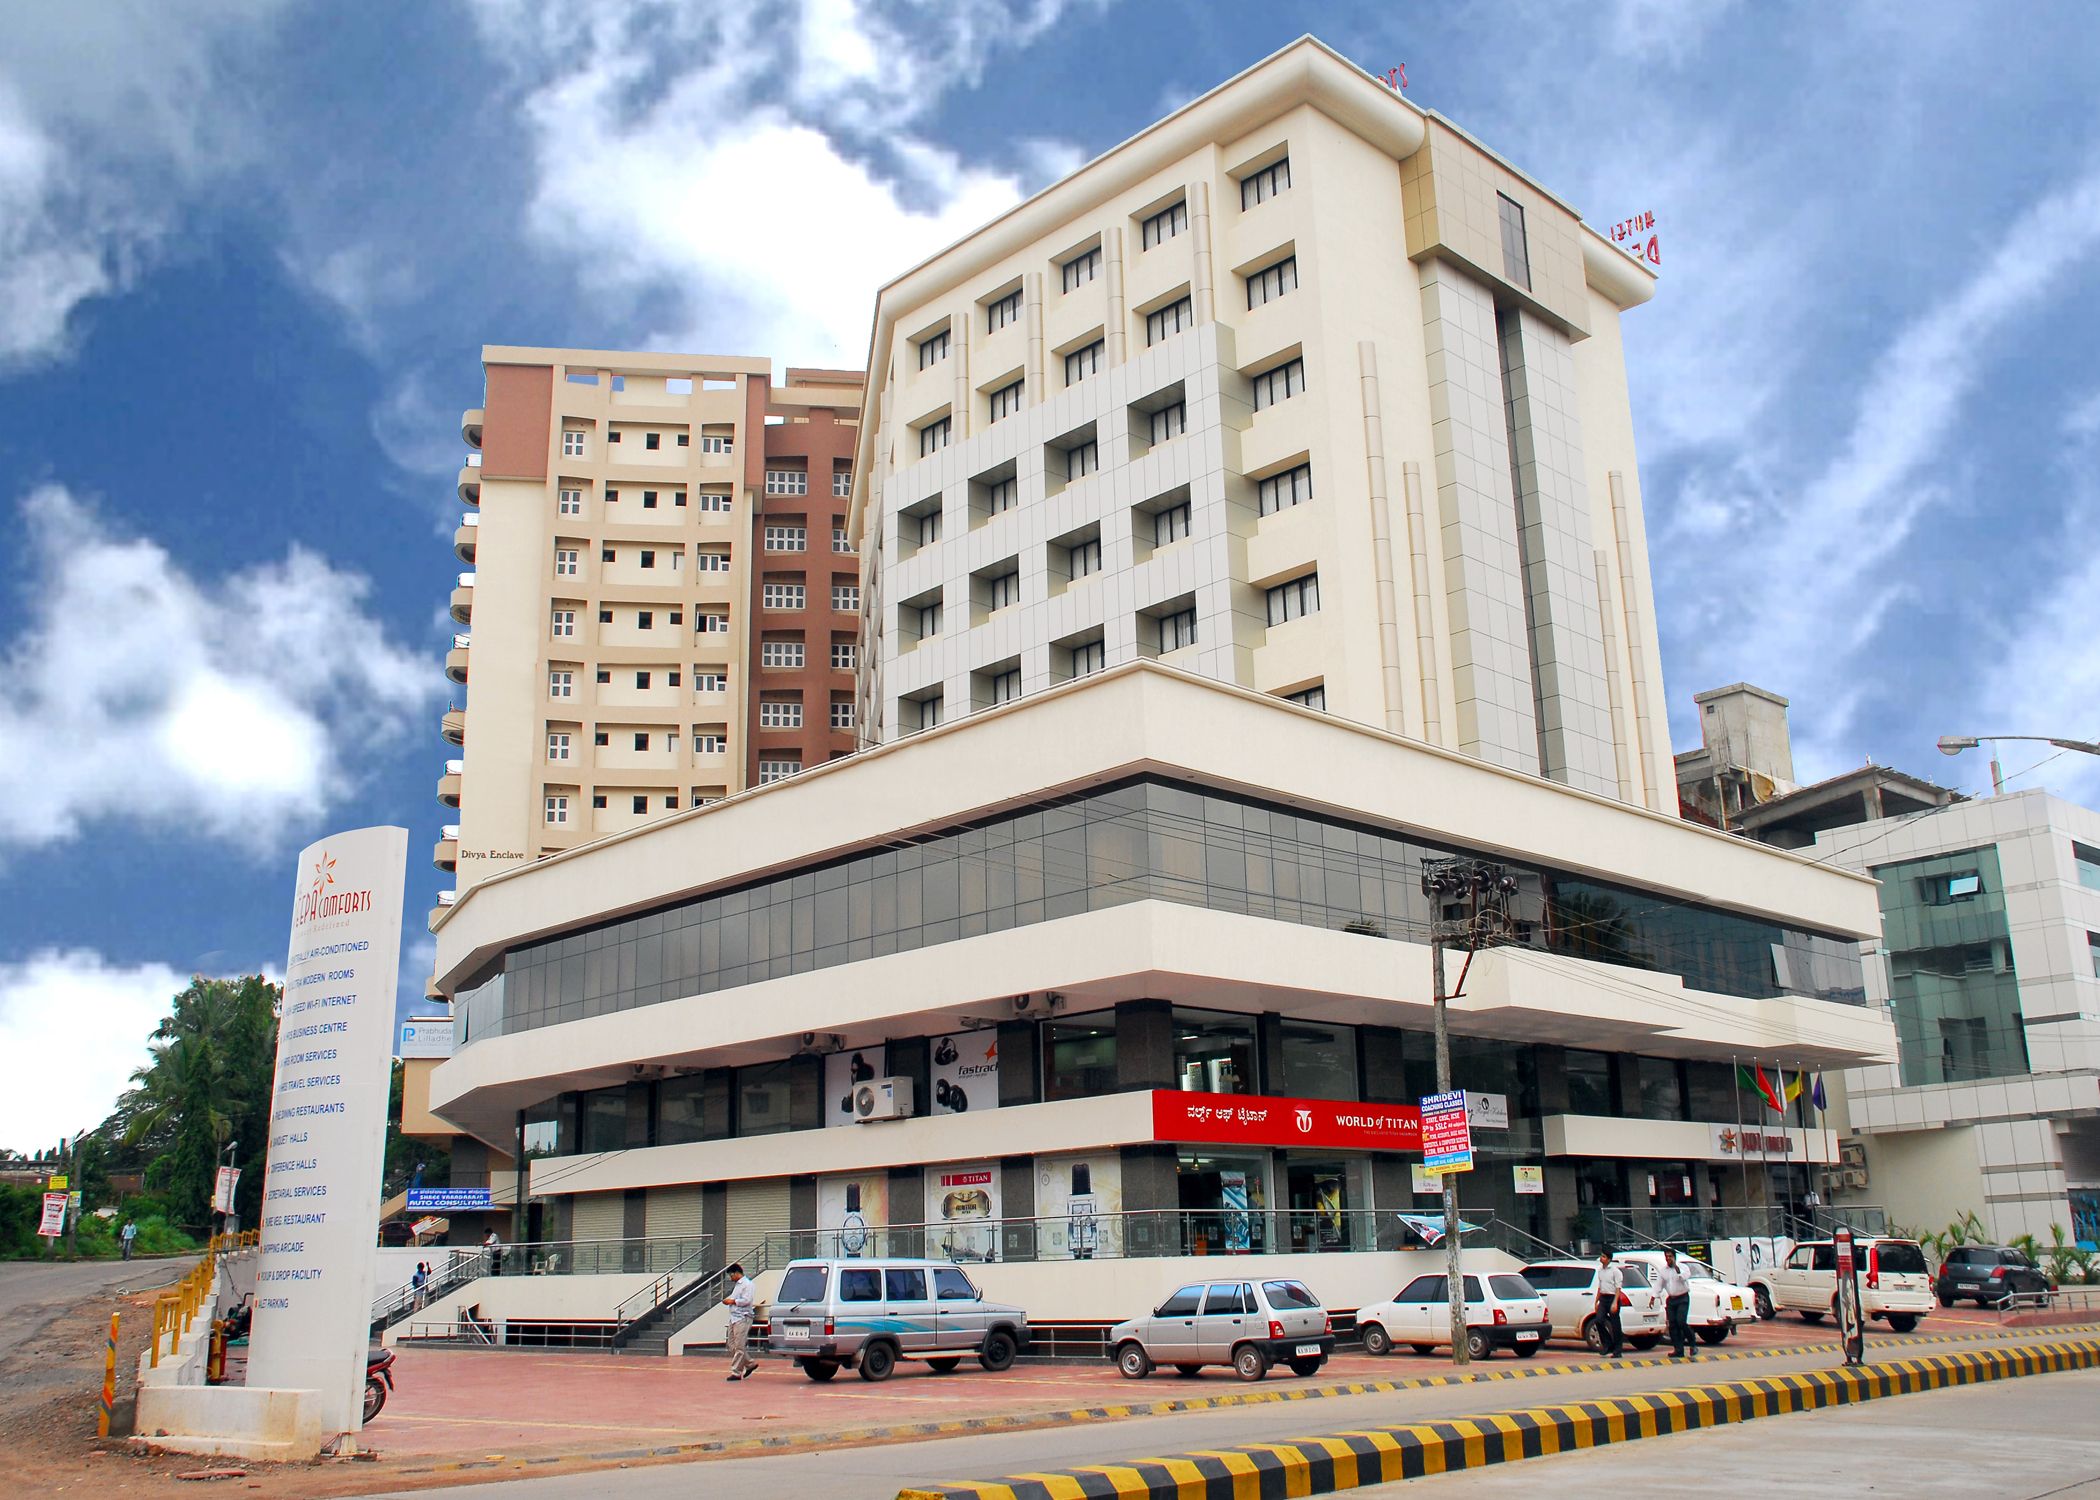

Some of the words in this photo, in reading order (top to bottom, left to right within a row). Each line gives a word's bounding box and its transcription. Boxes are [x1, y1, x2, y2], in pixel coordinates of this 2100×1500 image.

[461, 849, 487, 860] Divya
[490, 849, 525, 859] Enclave
[318, 890, 372, 919] COMFORTS
[309, 941, 369, 958] AIR-CONDITIONED
[328, 968, 355, 981] ROOMS
[321, 993, 357, 1007] INTERNET
[319, 1021, 348, 1034] CENTRE
[305, 1049, 338, 1062] SERVICES
[307, 1075, 341, 1087] SERVICES
[1422, 1092, 1462, 1105] SHRIDEVI
[296, 1102, 345, 1116] RESTAURANTS
[1336, 1115, 1374, 1128] WORLD
[1375, 1115, 1385, 1130] of
[1386, 1118, 1418, 1130] TITAN
[289, 1132, 308, 1144] HALLS
[296, 1158, 317, 1169] HALLS
[968, 1174, 988, 1183] TITAN
[294, 1185, 327, 1197] SERVICES
[283, 1212, 327, 1225] RESTAURANT
[280, 1241, 304, 1252] ARCADE
[291, 1268, 323, 1280] FACILITY
[267, 1298, 289, 1308] PARKING
